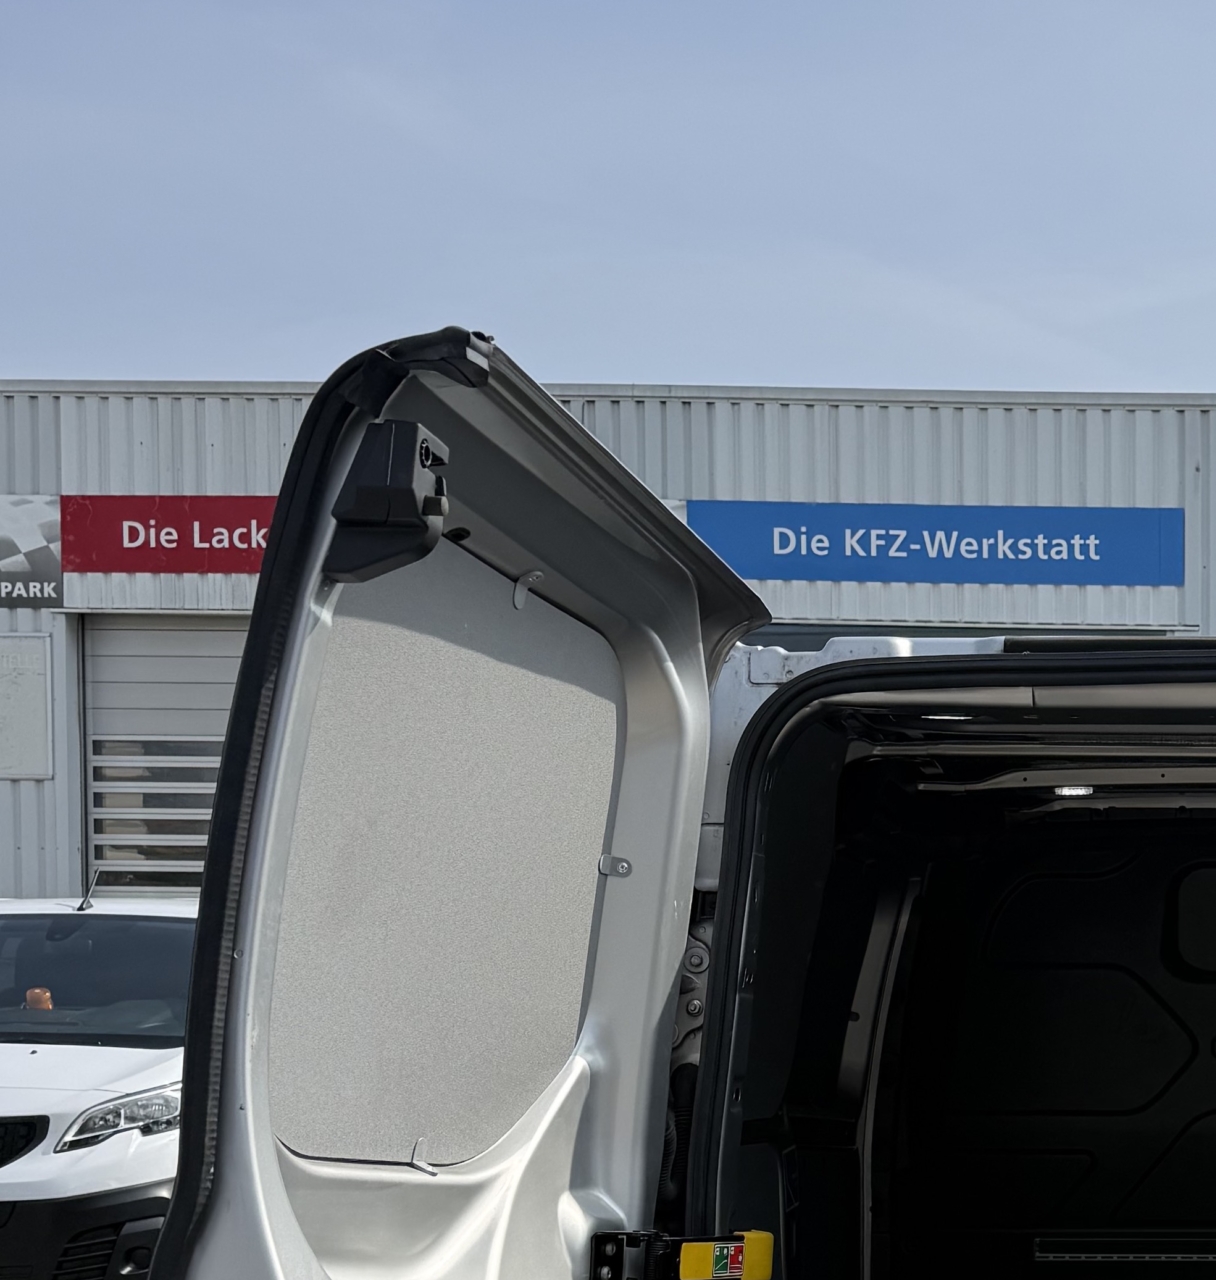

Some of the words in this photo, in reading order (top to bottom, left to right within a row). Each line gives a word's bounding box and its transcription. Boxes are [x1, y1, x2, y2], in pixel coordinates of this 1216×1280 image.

[122, 519, 178, 548] Die
[193, 519, 268, 548] Lack
[773, 526, 829, 555] Die
[844, 528, 1101, 560] KFZ-Werkstatt
[0, 581, 57, 598] PARK
